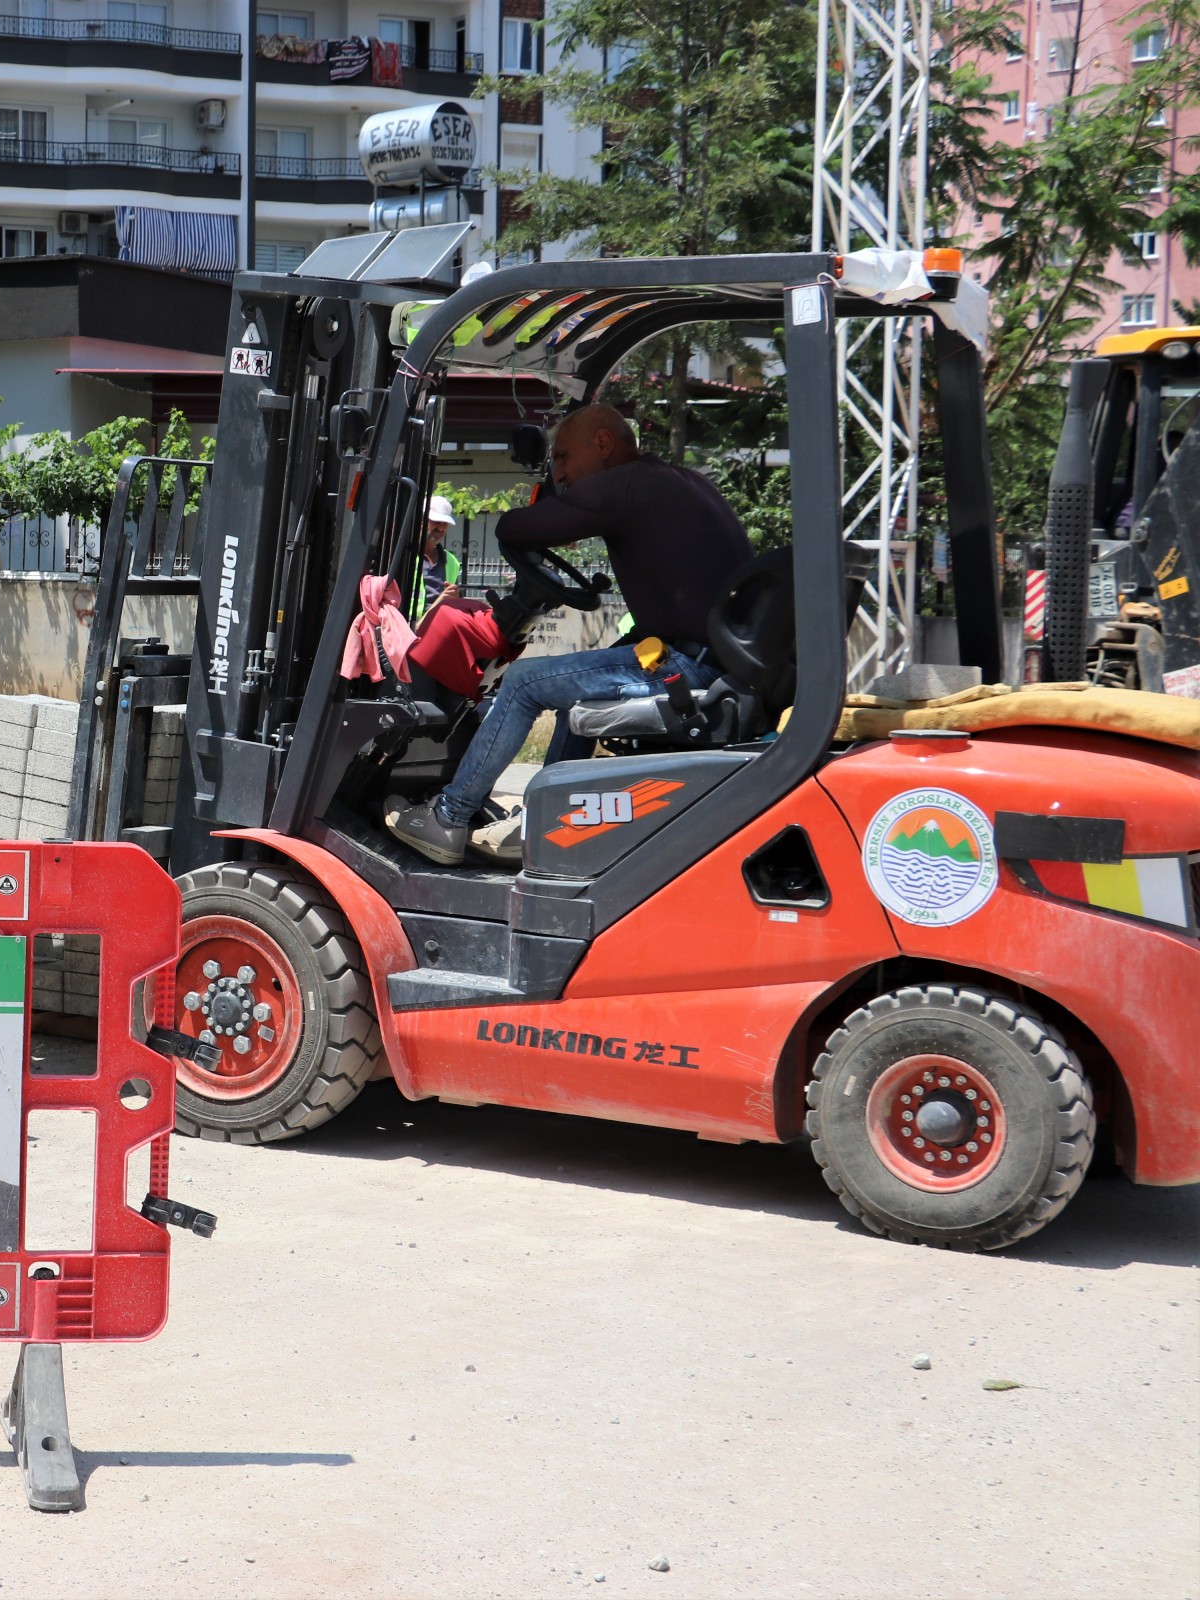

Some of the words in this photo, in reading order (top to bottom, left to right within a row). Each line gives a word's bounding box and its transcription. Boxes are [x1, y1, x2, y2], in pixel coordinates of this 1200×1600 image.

[370, 119, 420, 148] ESER
[430, 115, 472, 142] ESER
[569, 791, 633, 826] 30
[869, 814, 891, 867] MERSİN
[889, 793, 962, 816] TOROSLAR
[905, 907, 939, 920] 1994
